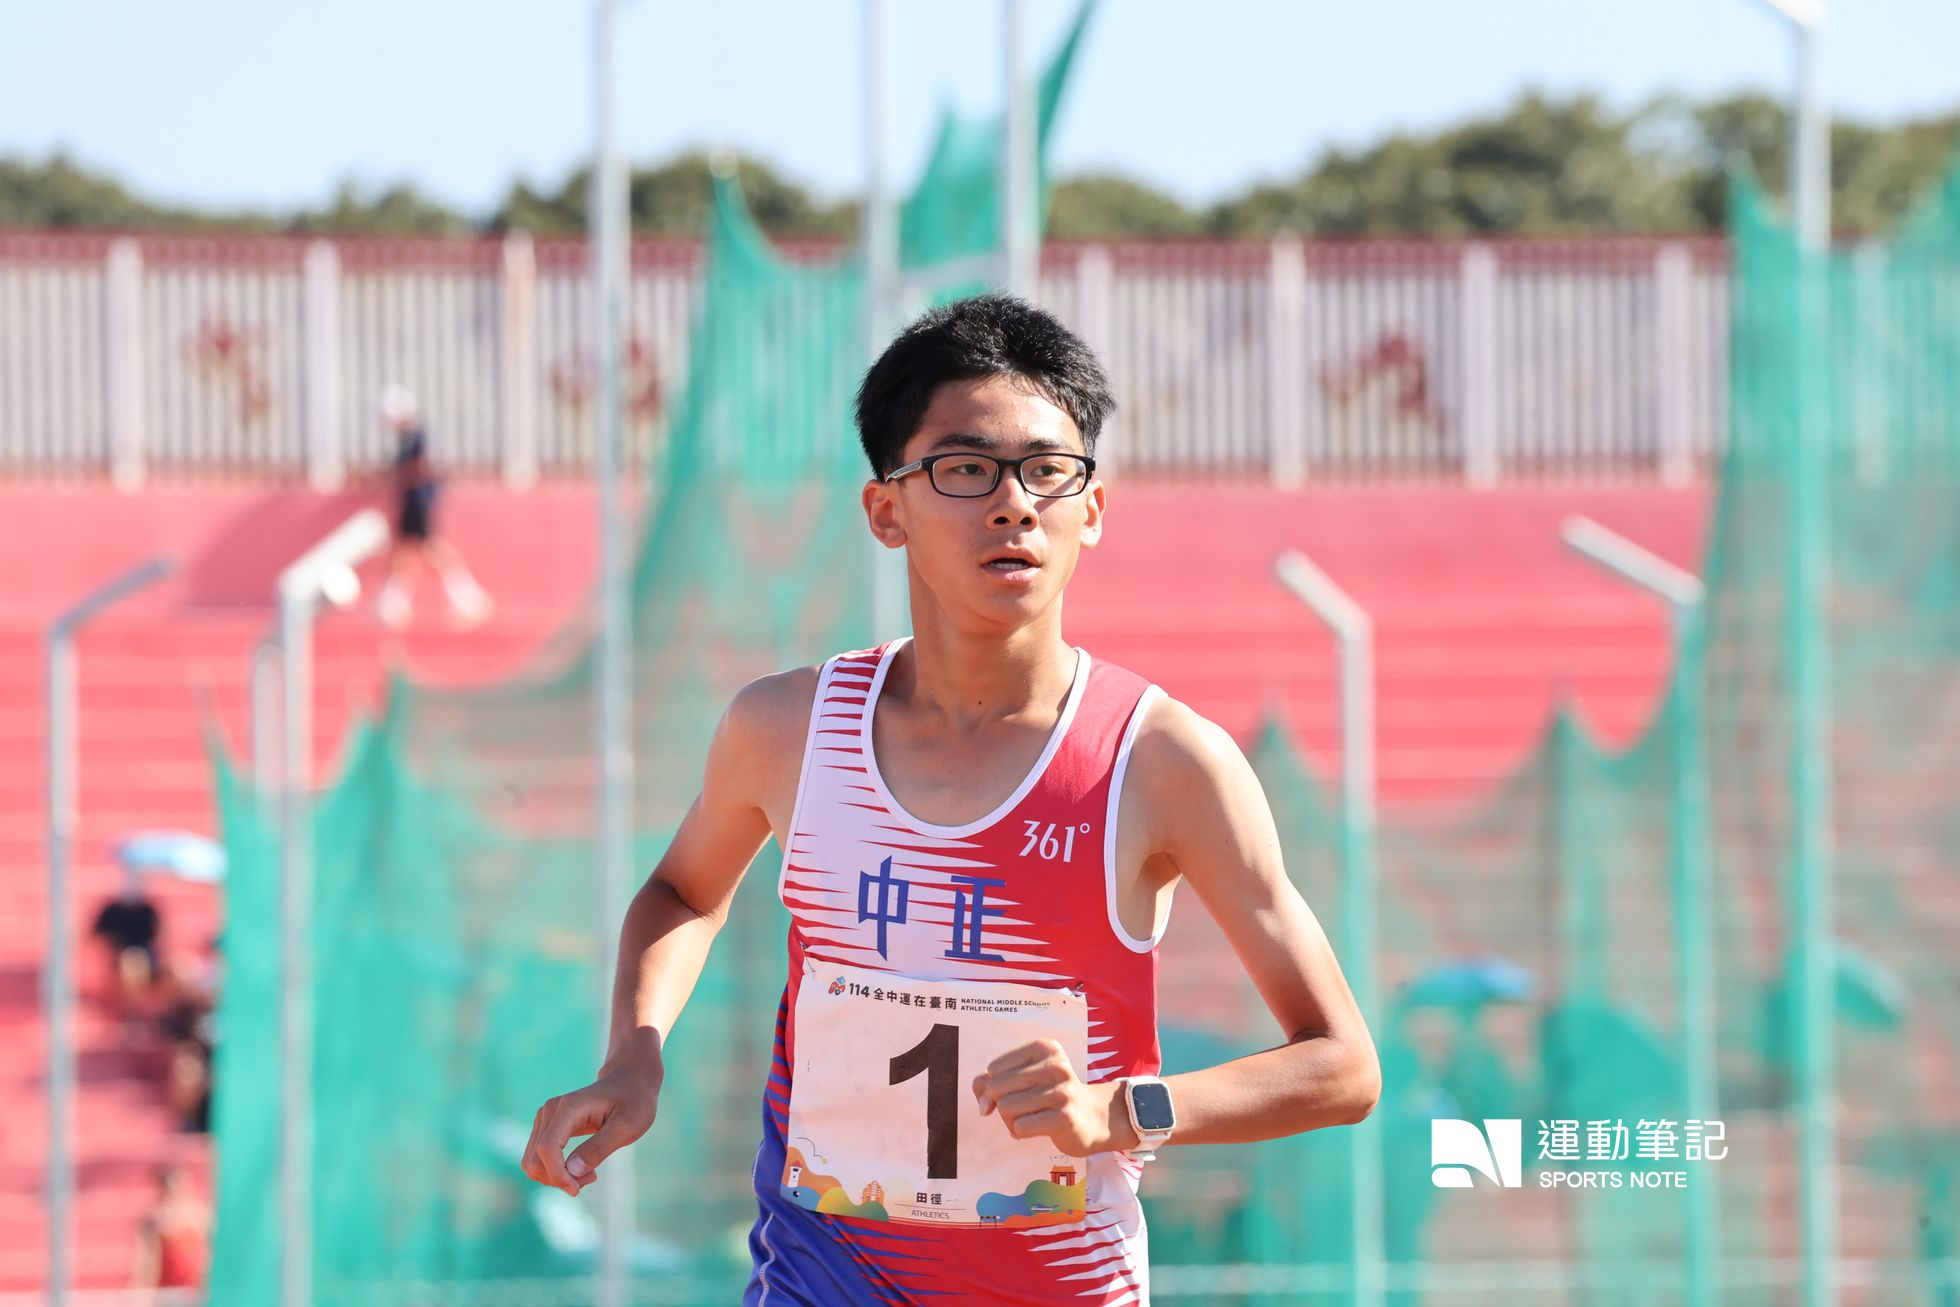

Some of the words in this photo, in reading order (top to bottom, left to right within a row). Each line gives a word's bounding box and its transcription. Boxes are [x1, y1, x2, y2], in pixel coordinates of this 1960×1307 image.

[857, 854, 1007, 963] 中正
[889, 1023, 960, 1180] 1
[911, 1209, 950, 1219] ATHLETICS
[916, 1192, 943, 1206] 田徑
